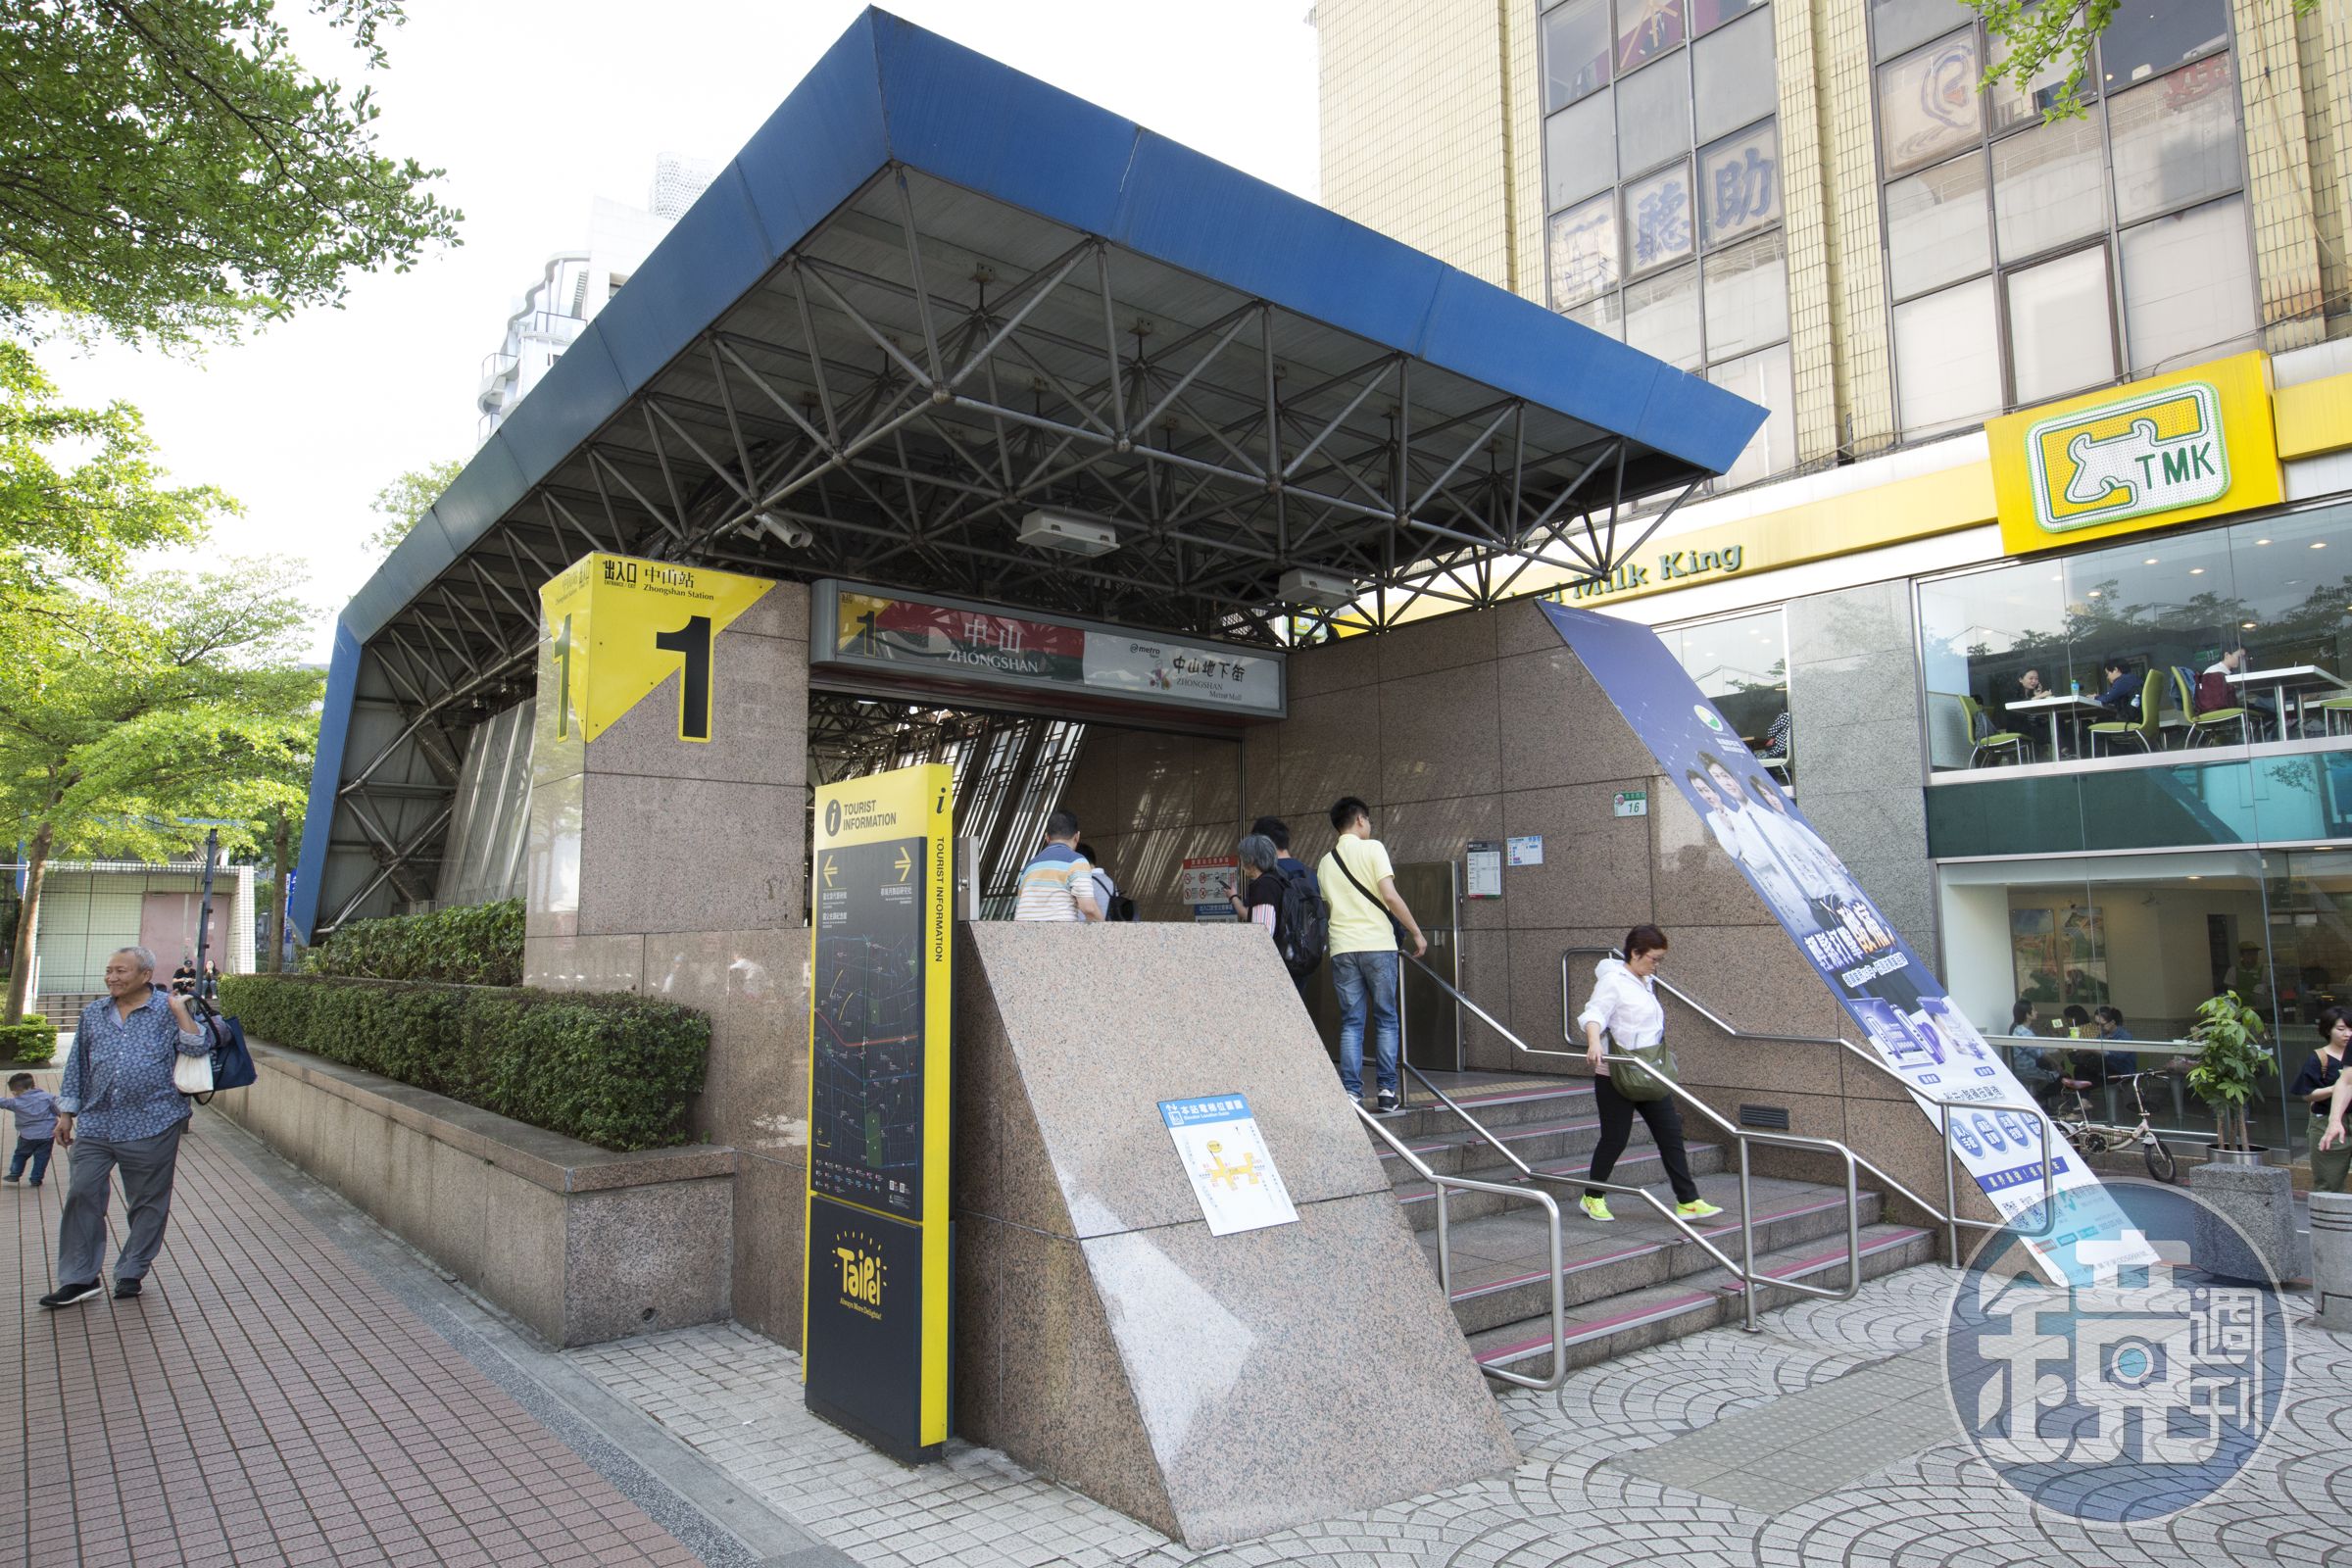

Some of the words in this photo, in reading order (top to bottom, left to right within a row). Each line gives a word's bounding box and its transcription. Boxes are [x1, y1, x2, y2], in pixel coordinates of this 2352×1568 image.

[2134, 441, 2216, 490] TMK
[604, 560, 637, 584] 出入口
[644, 566, 695, 589] 中山站
[1658, 545, 1742, 580] King
[643, 583, 686, 597] Zhongshan
[687, 590, 714, 601] Station
[857, 611, 875, 656] 1
[963, 617, 1022, 654] 中山
[555, 612, 572, 739] 1
[656, 614, 711, 739] 1
[947, 649, 1039, 674] ZHONGSHAN
[1172, 655, 1246, 683] 中山地下街
[1176, 677, 1224, 691] ZHONGSHAN
[843, 811, 897, 831] INFORMATION
[844, 800, 877, 816] TOURIST
[1628, 802, 1641, 813] 16
[936, 837, 945, 884] TOURIST
[935, 886, 944, 962] INFORMATION
